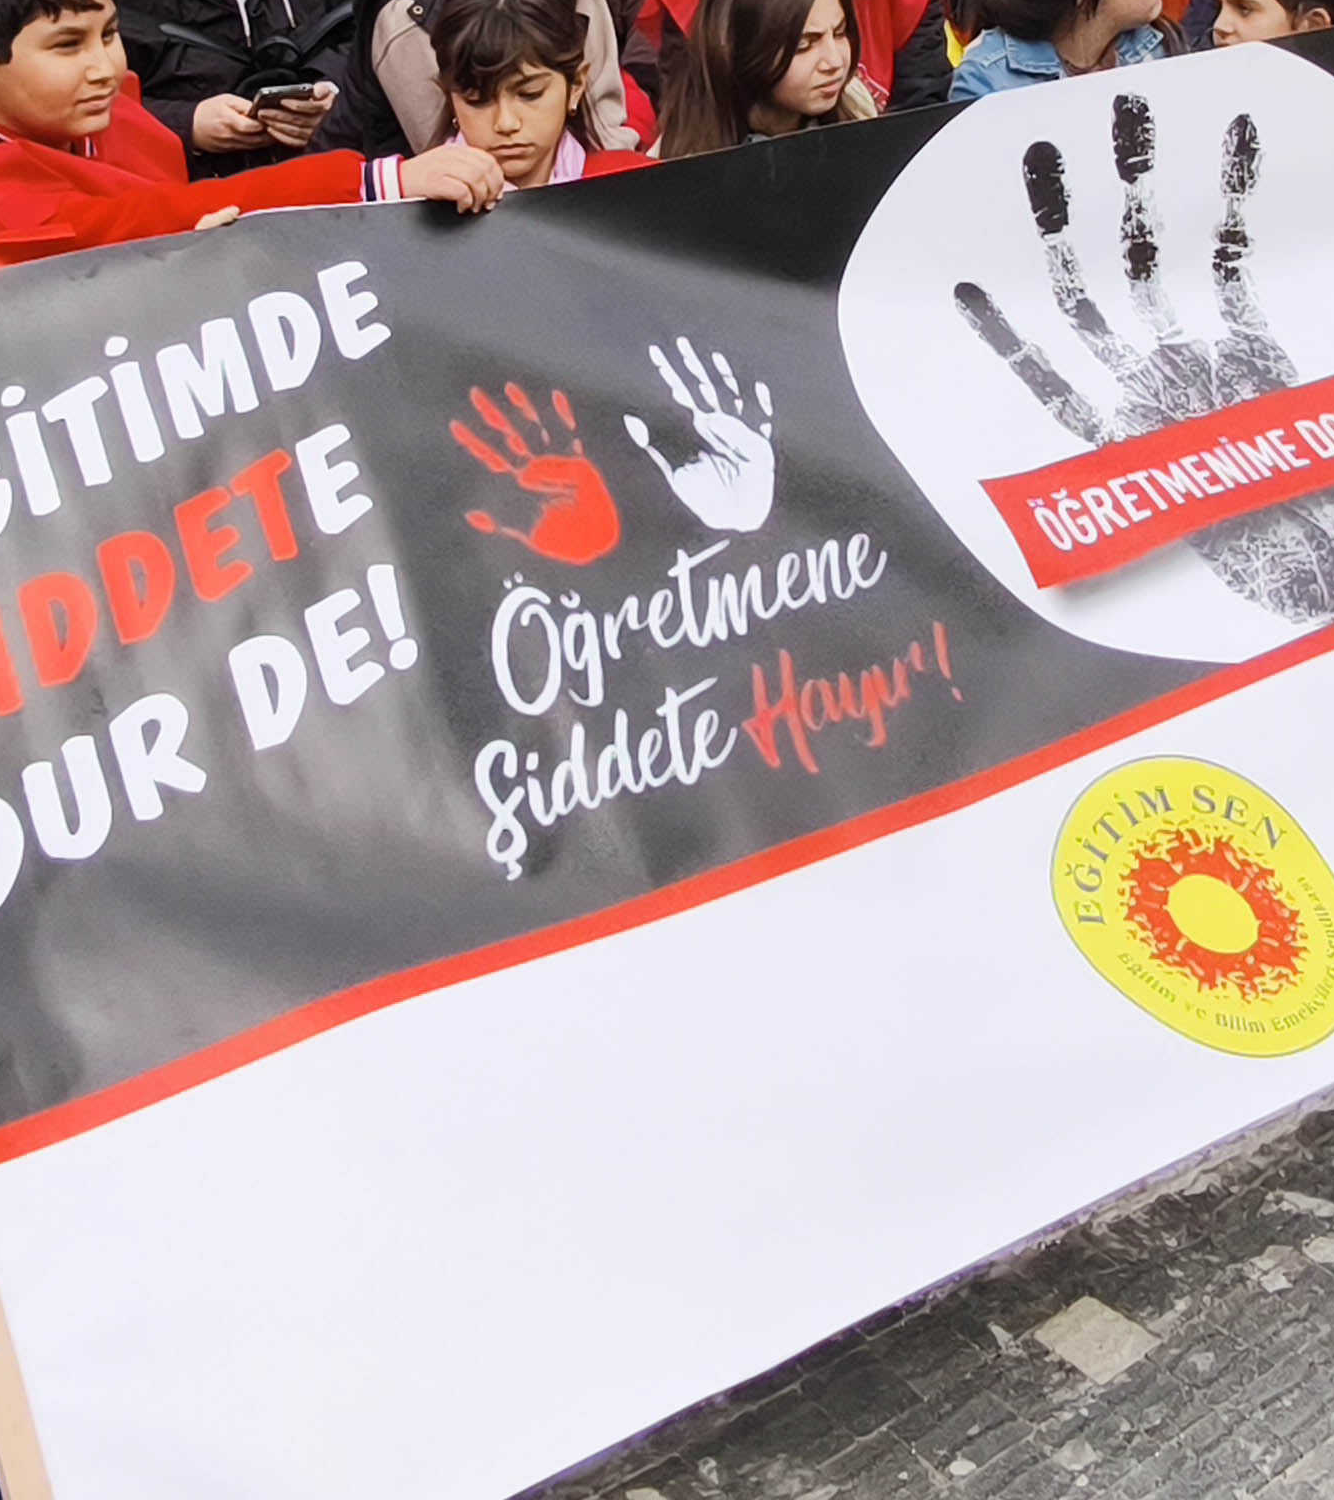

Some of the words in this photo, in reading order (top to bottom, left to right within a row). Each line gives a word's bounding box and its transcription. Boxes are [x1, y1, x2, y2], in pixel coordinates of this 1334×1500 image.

[1025, 426, 1304, 554] ÖĞRETMENİME
[228, 563, 420, 752] DE!
[491, 531, 887, 716] Öğretmene
[473, 676, 739, 881] Şiddete
[1064, 785, 1175, 927] EĞİTİM
[1190, 784, 1288, 850] SEN
